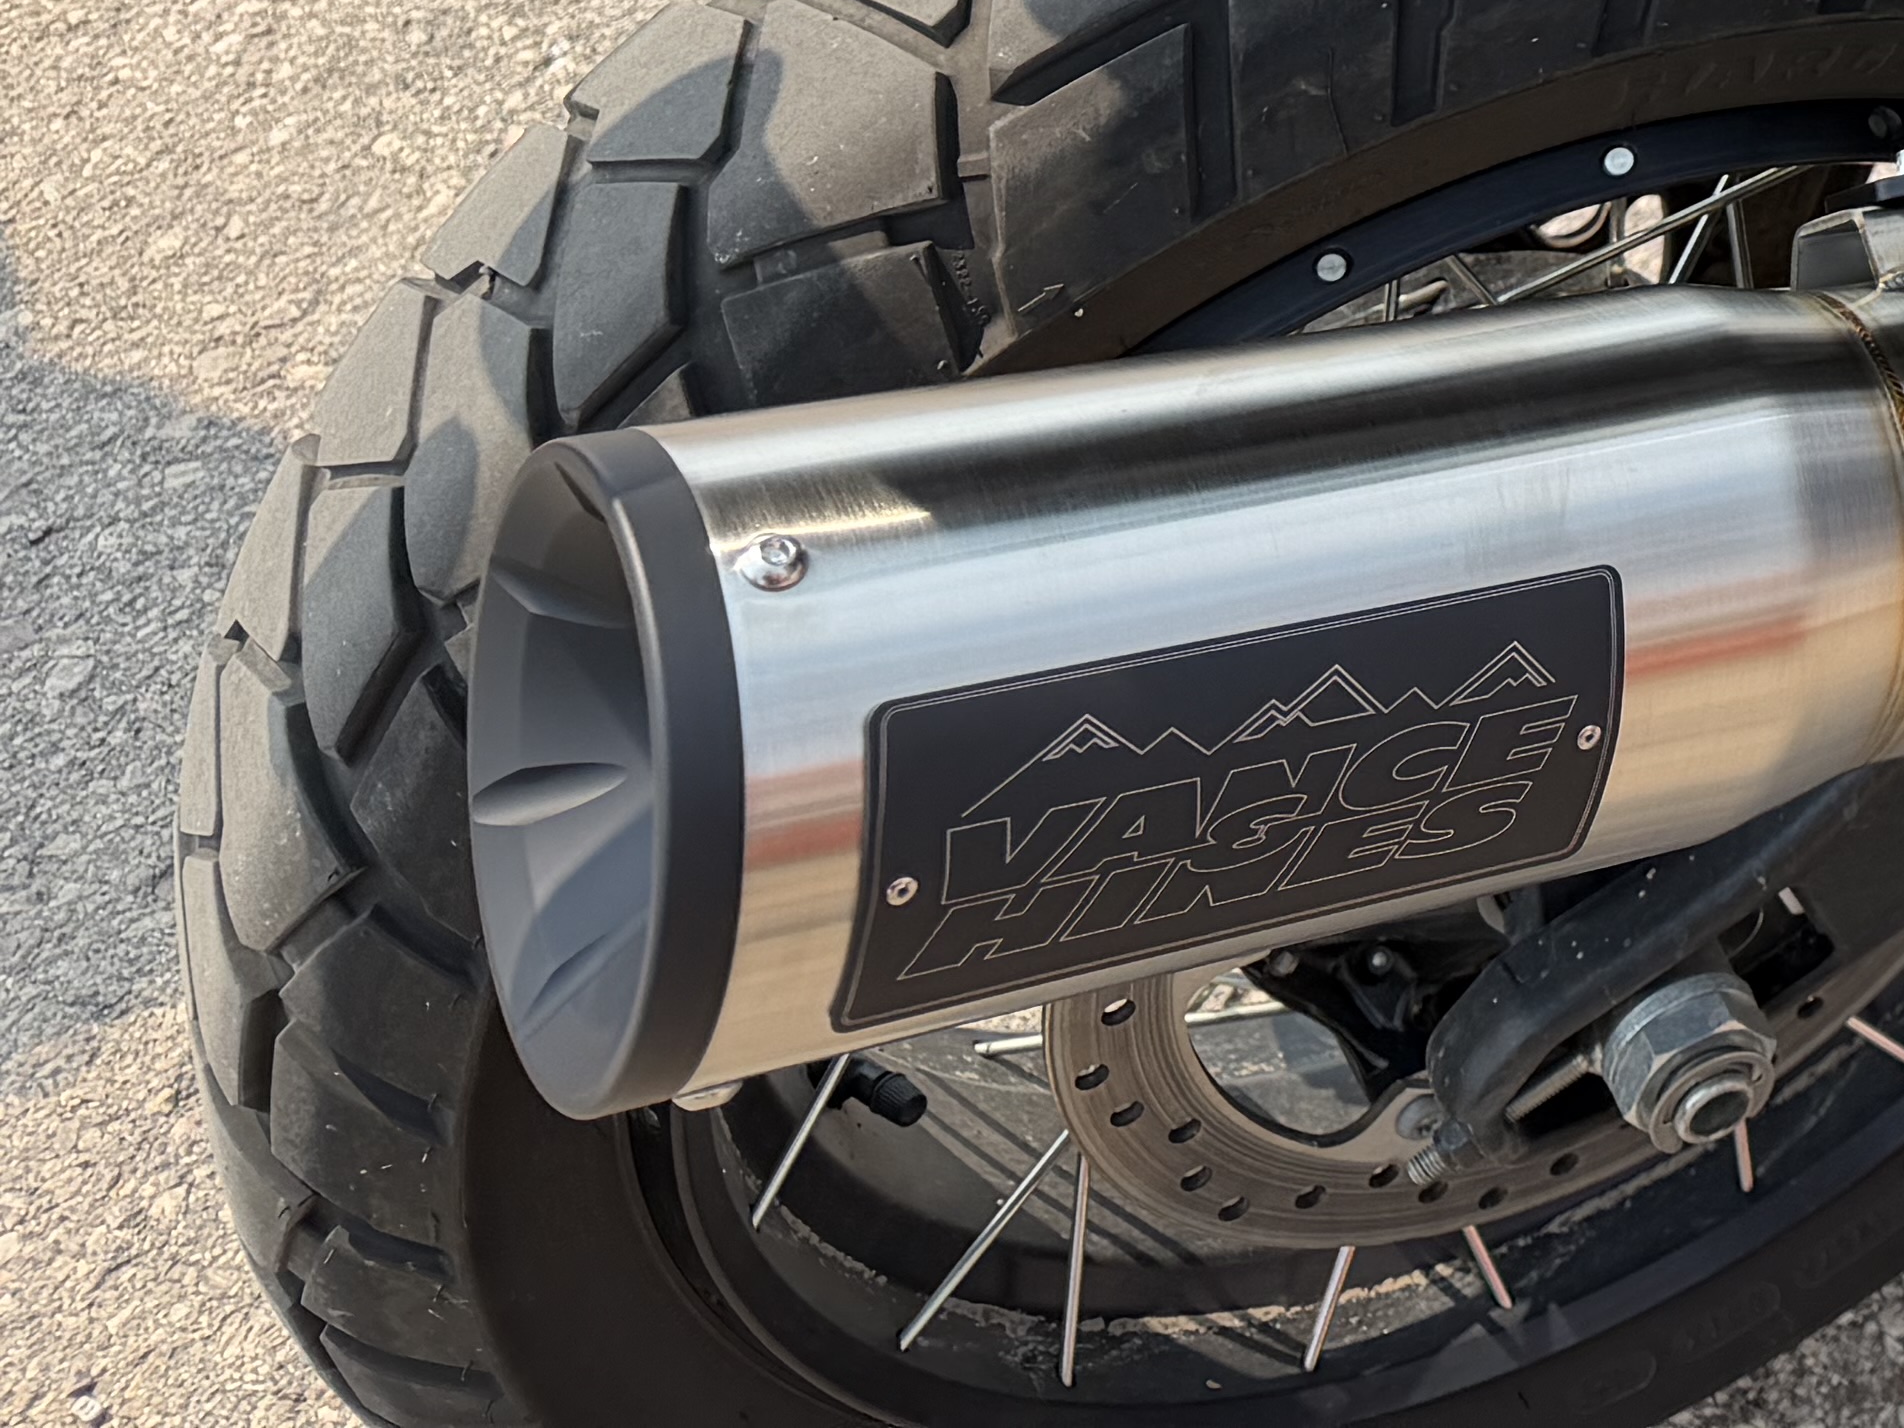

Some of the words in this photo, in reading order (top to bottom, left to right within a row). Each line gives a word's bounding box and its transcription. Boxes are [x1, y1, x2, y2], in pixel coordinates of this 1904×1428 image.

[896, 780, 1532, 981] HINES
[941, 693, 1579, 905] VANCE
[1188, 792, 1308, 874] &
